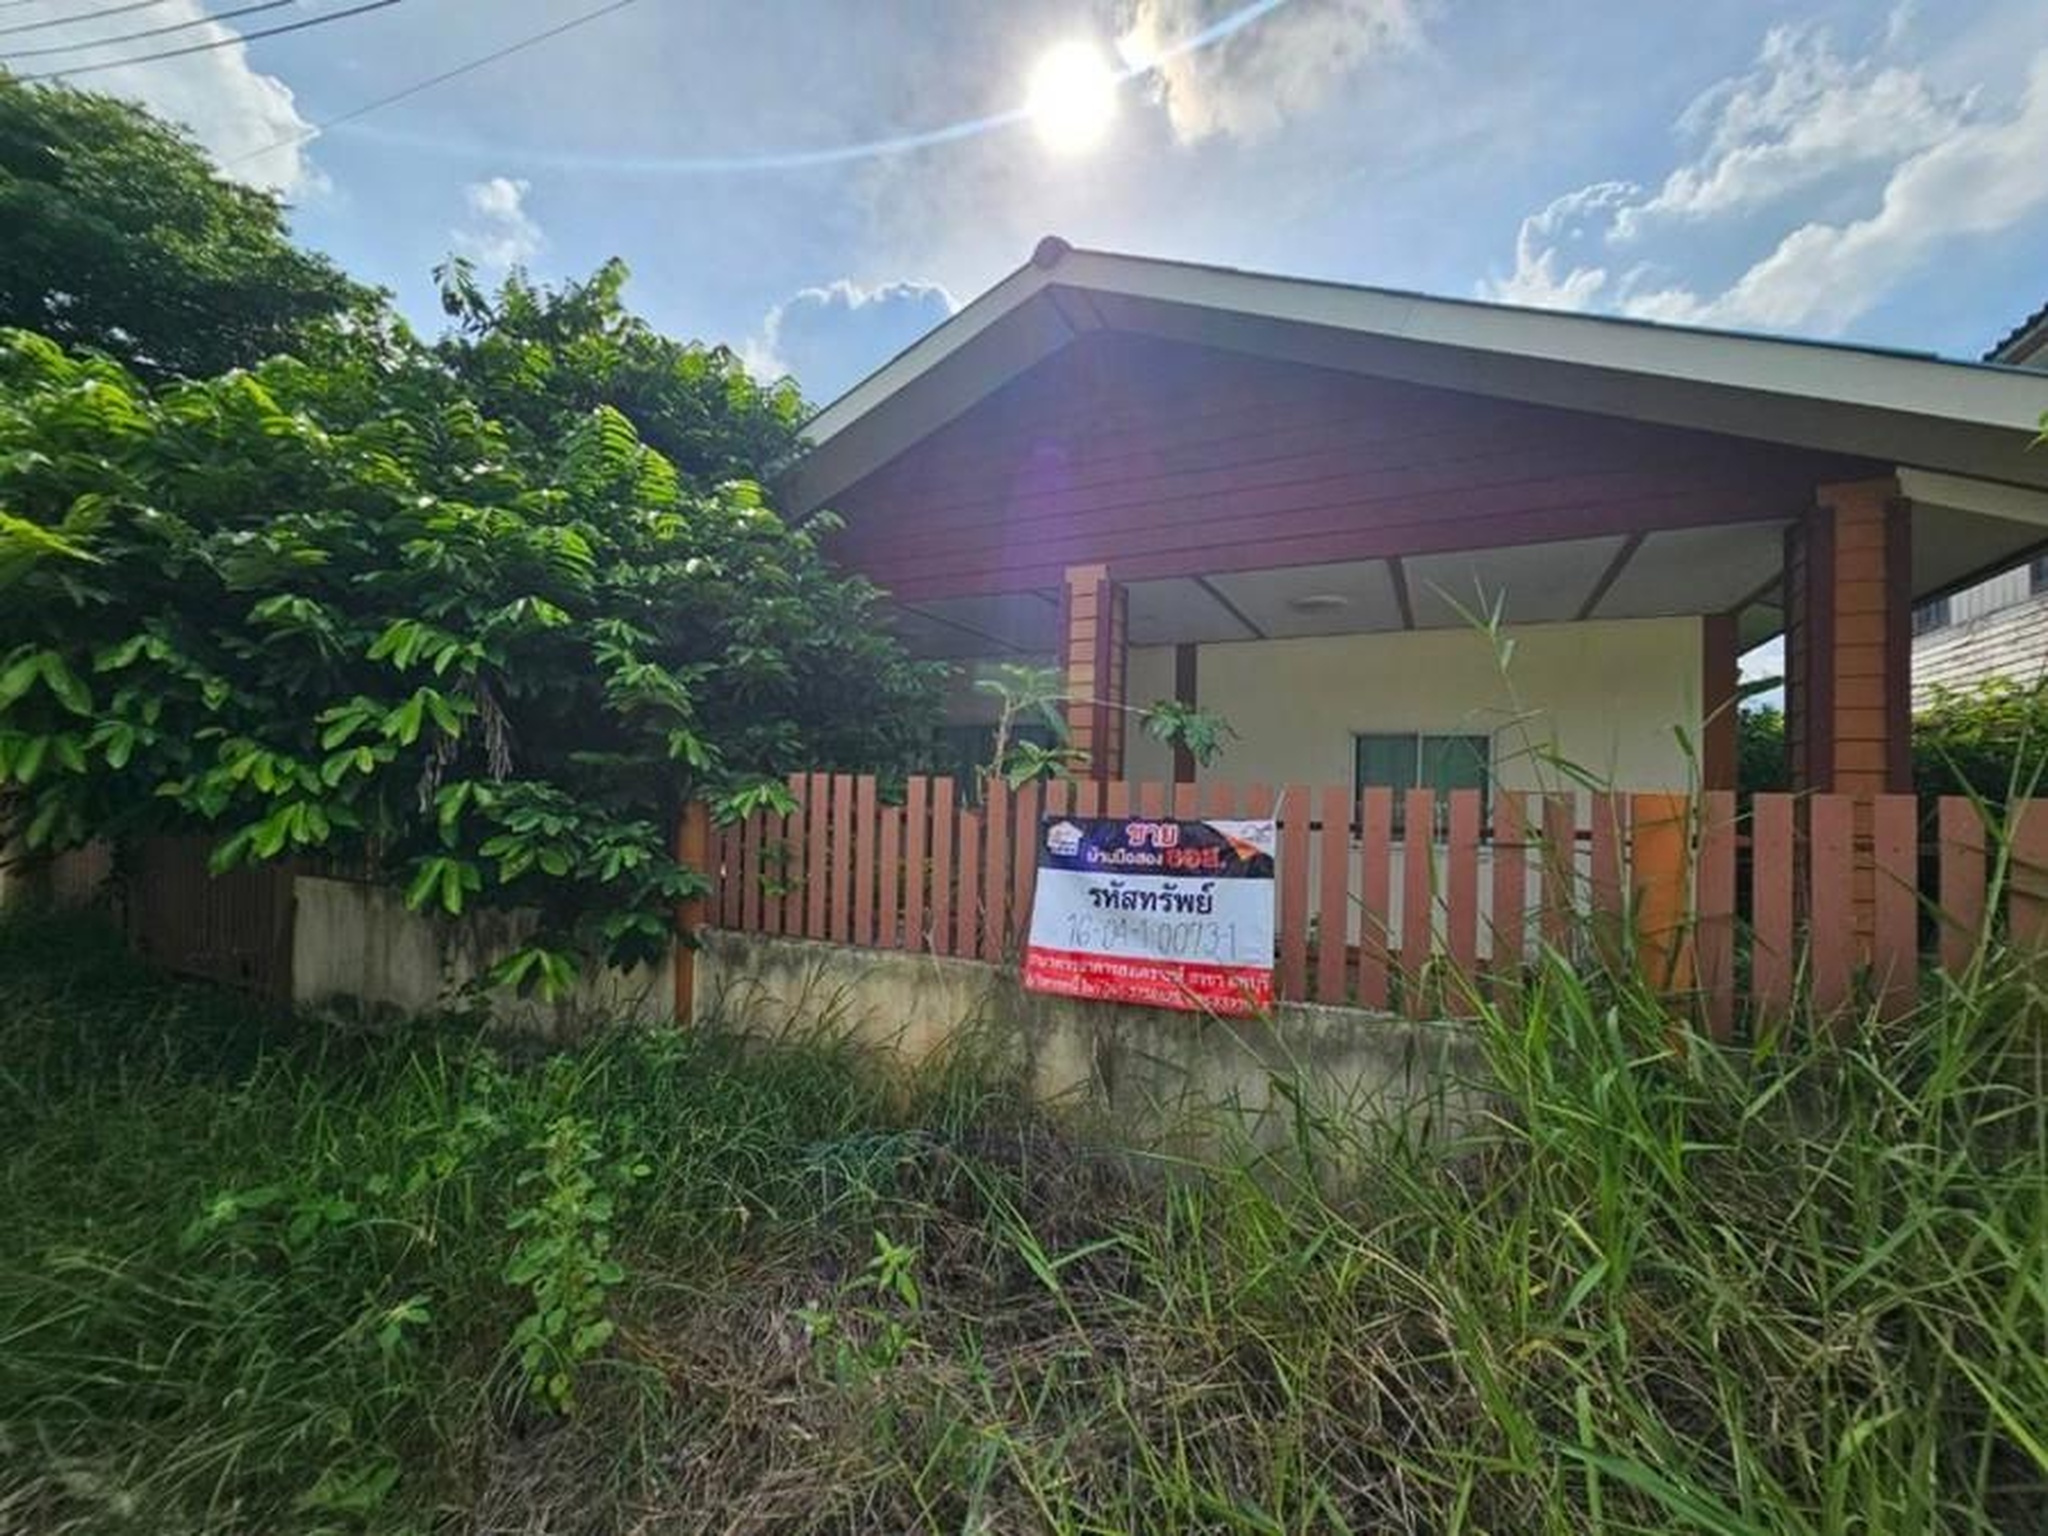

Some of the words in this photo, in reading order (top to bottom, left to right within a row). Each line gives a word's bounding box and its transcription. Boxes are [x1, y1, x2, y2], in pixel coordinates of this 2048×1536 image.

[1125, 821, 1179, 848] ขาย
[1086, 847, 1163, 867] บ้านมือสอง
[1088, 880, 1216, 915] รหัสทรัพย์
